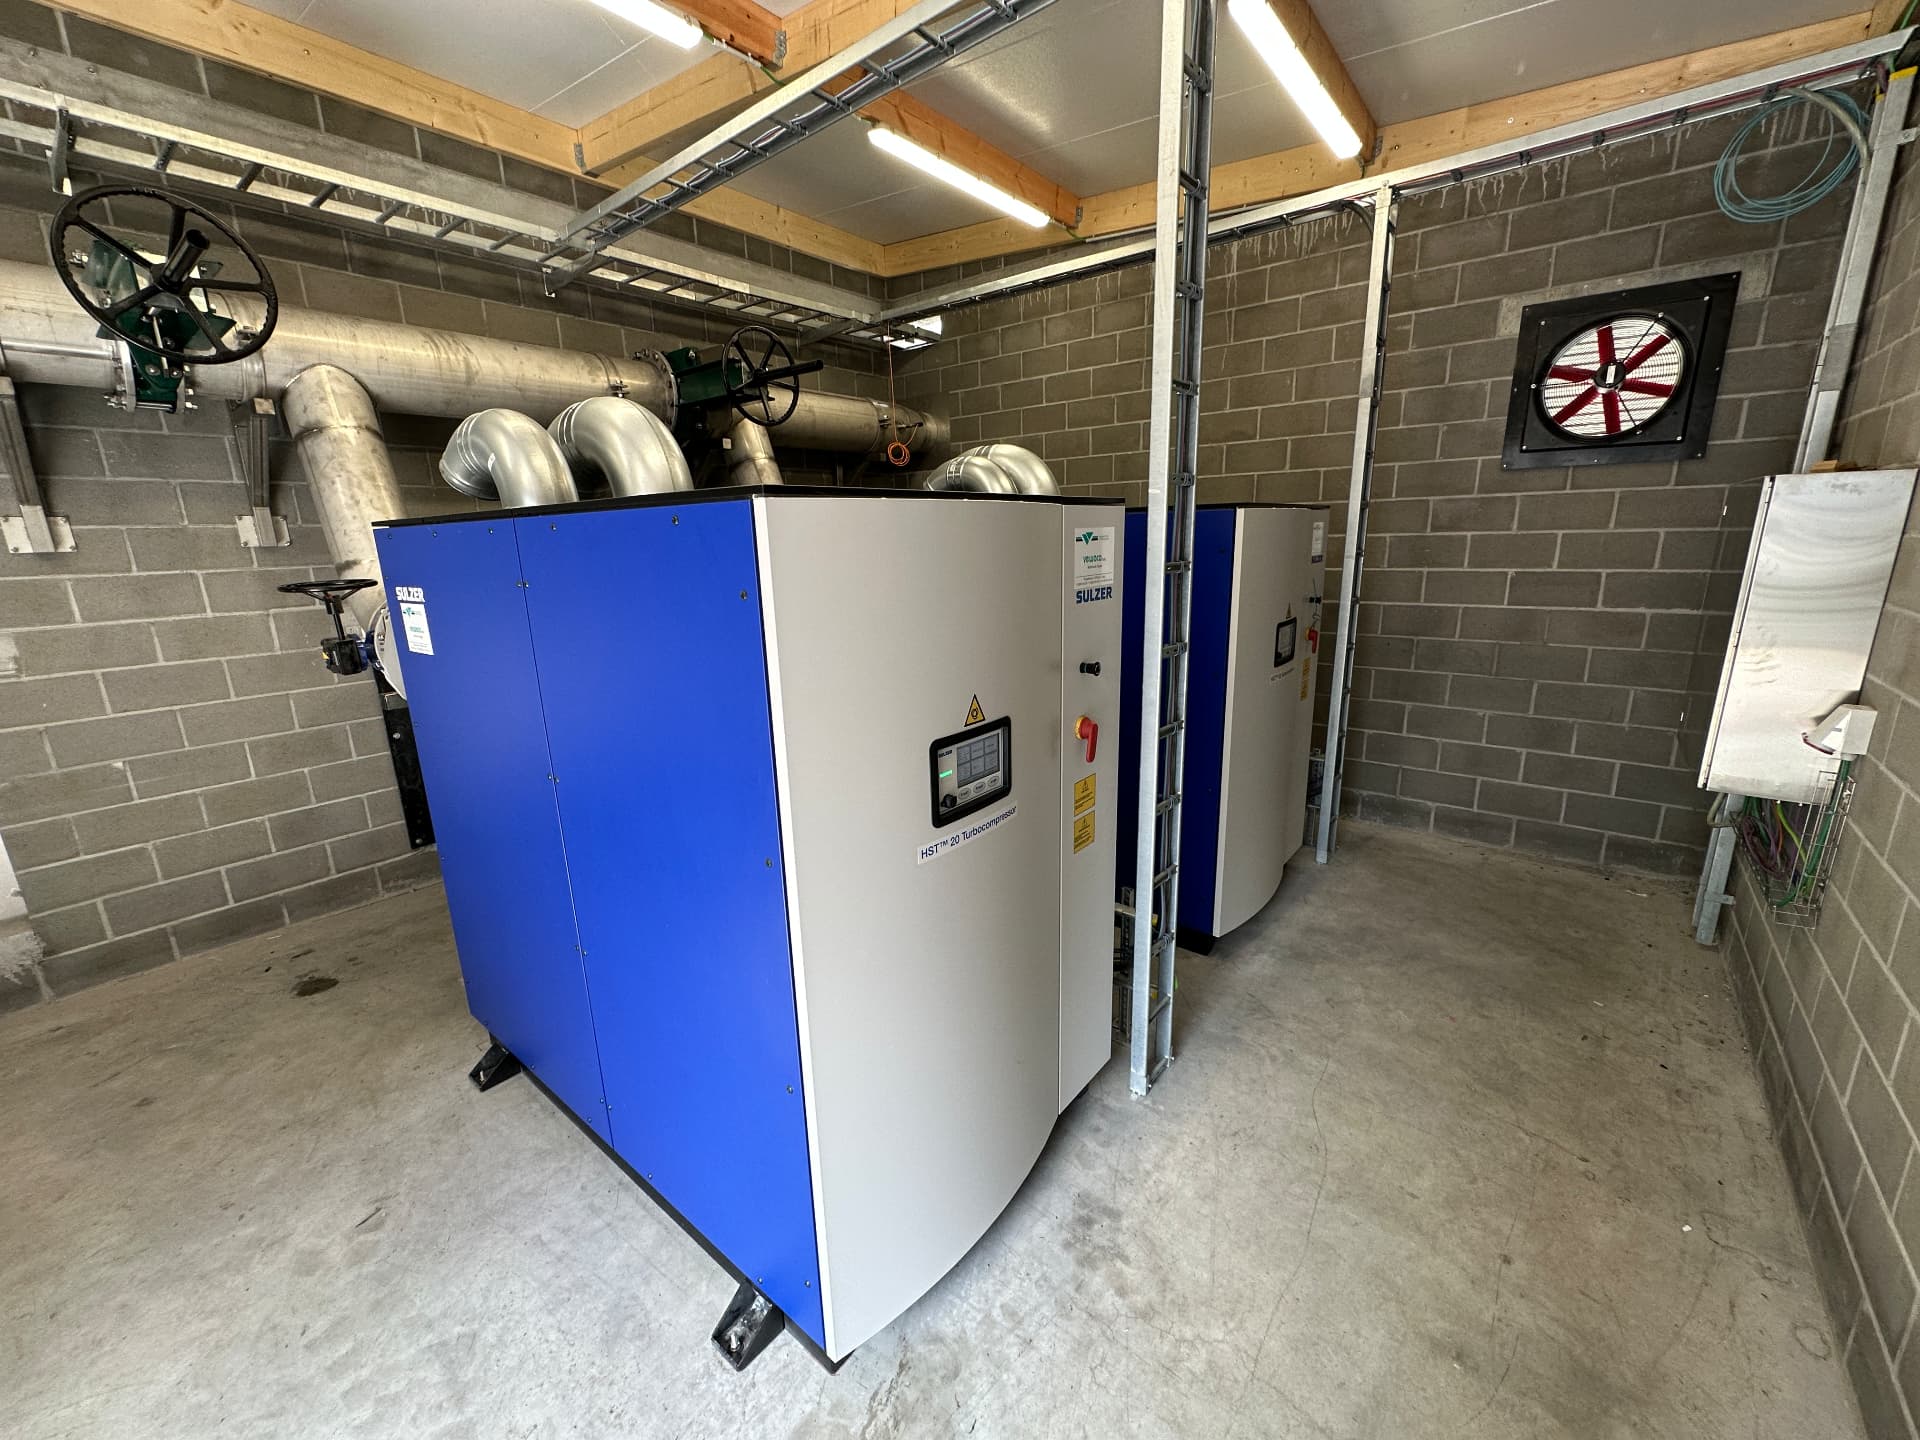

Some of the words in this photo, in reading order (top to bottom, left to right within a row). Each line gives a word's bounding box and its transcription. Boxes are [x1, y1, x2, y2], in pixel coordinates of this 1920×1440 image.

[396, 587, 425, 602] SULZER
[1076, 586, 1112, 604] SULZER
[950, 835, 960, 847] 20
[962, 806, 1017, 840] Turbocompressor
